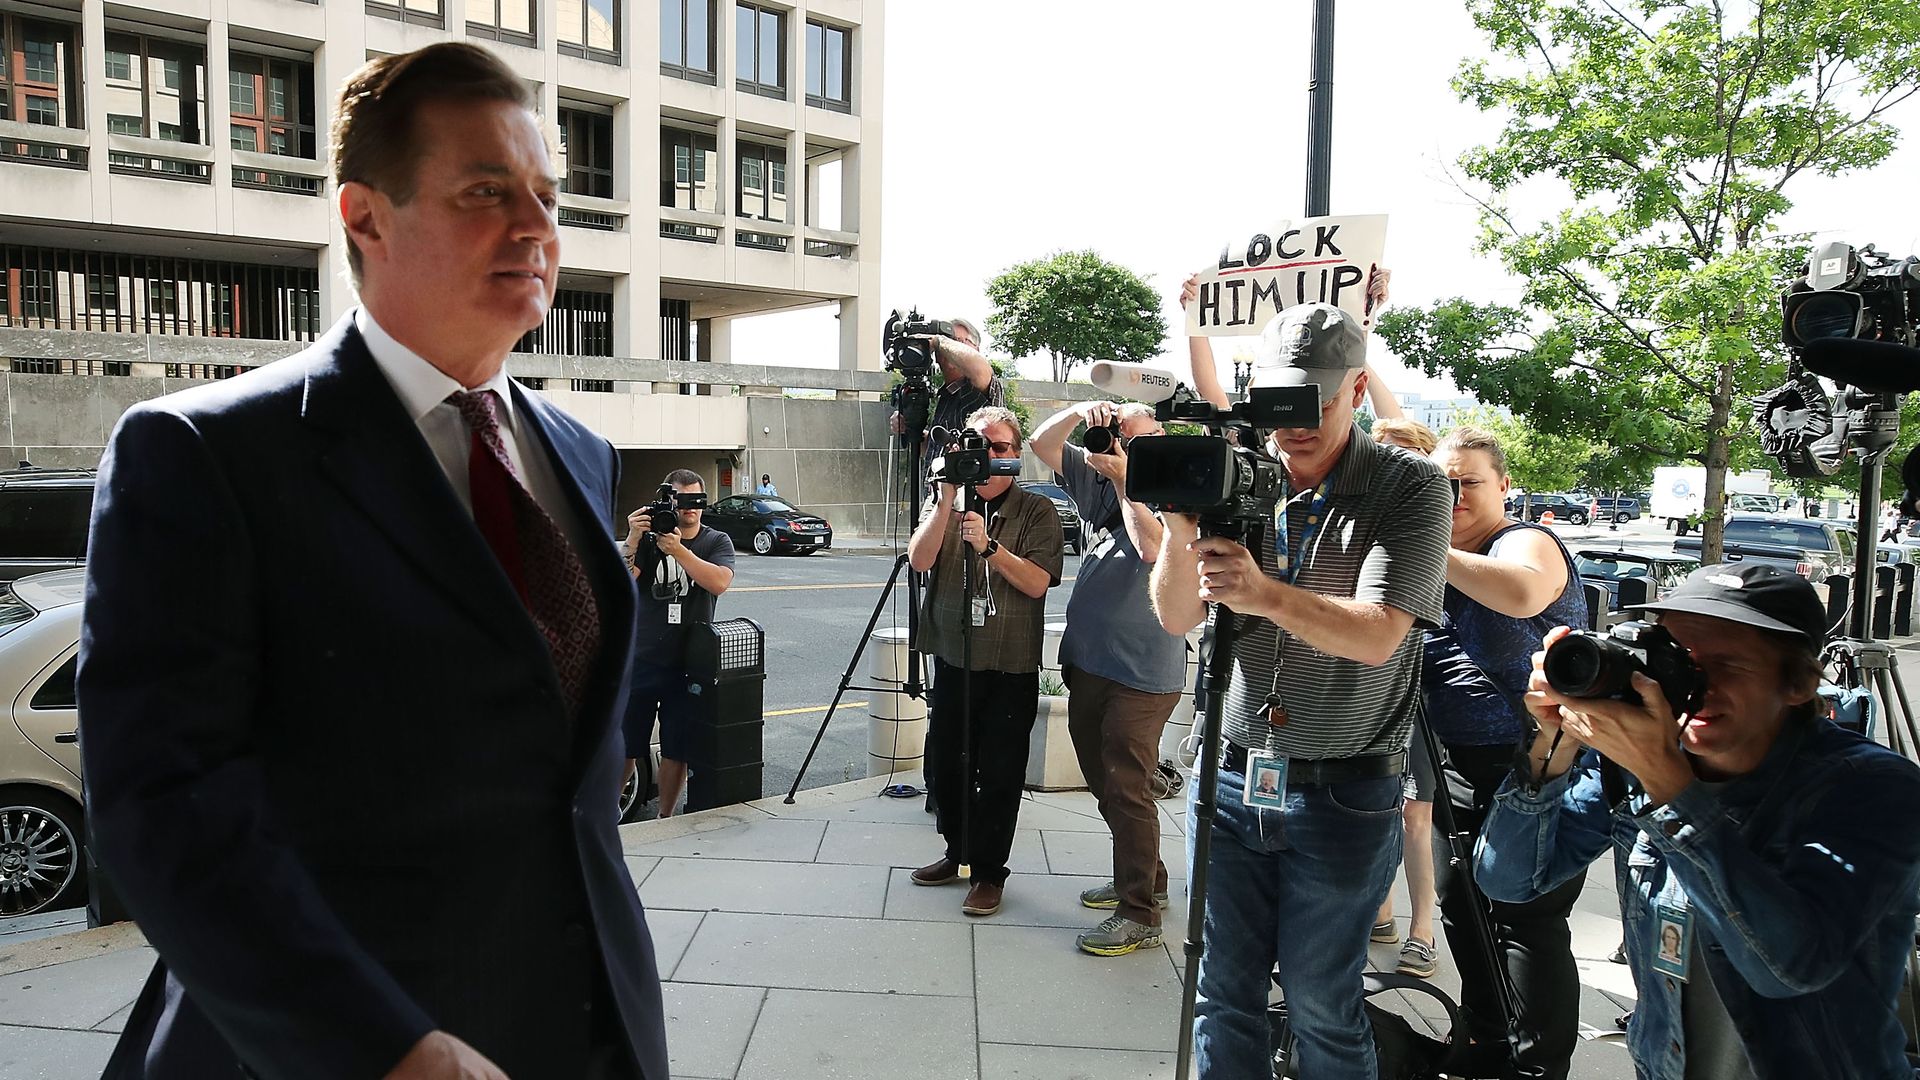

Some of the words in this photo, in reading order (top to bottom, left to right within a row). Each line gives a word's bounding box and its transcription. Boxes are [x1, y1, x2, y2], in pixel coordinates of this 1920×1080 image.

[1218, 225, 1342, 270] LOCK
[1199, 277, 1284, 327] HIM
[1296, 262, 1377, 327] UP!
[1141, 374, 1170, 387] REUTERS
